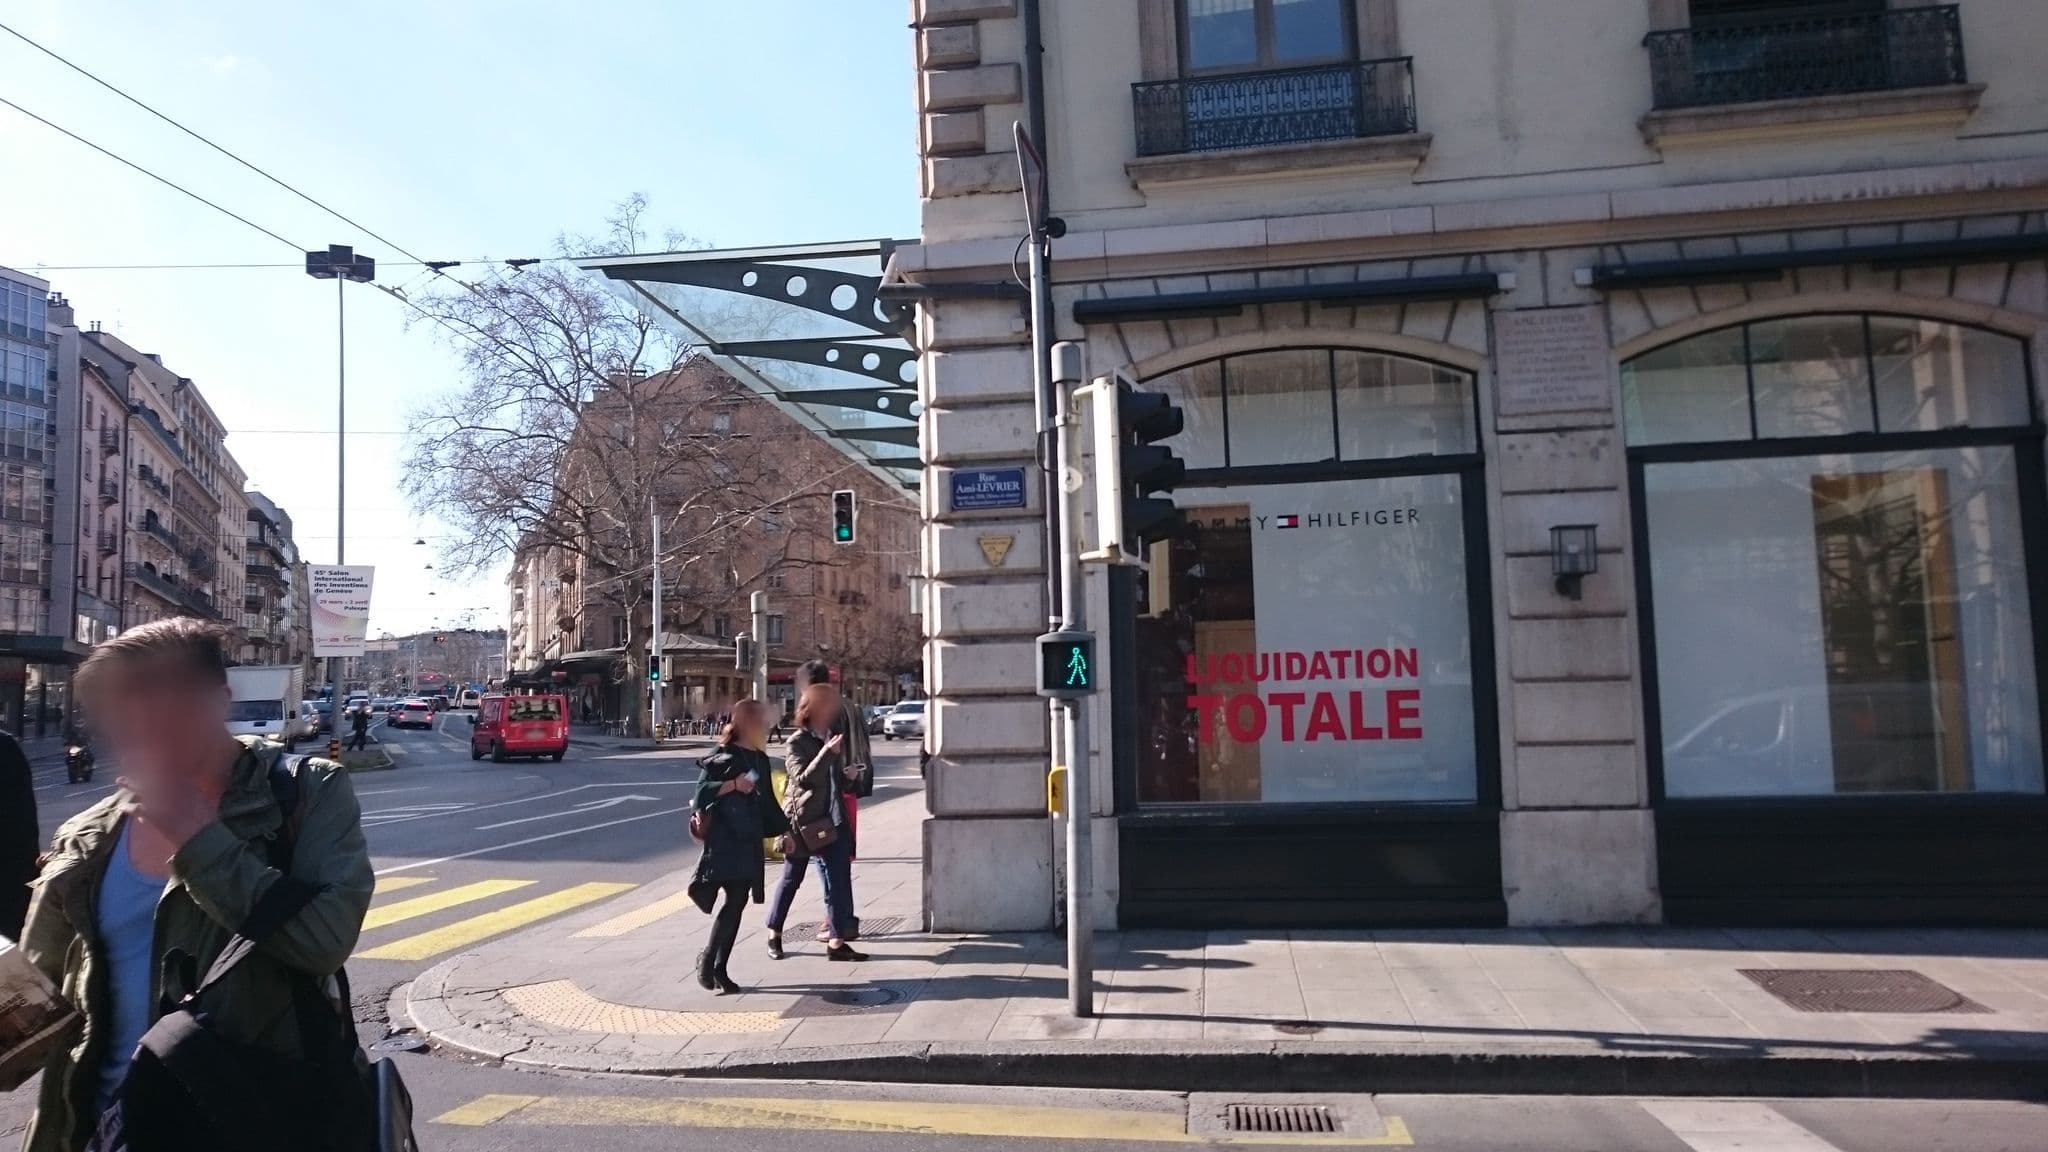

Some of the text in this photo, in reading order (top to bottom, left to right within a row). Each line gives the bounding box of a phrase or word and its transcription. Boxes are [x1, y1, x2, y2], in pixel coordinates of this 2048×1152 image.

[979, 473, 997, 482] Rue
[1307, 508, 1420, 528] HILFIGER
[1185, 648, 1418, 684] LIQUIDATION
[1187, 689, 1422, 744] TOTALE
